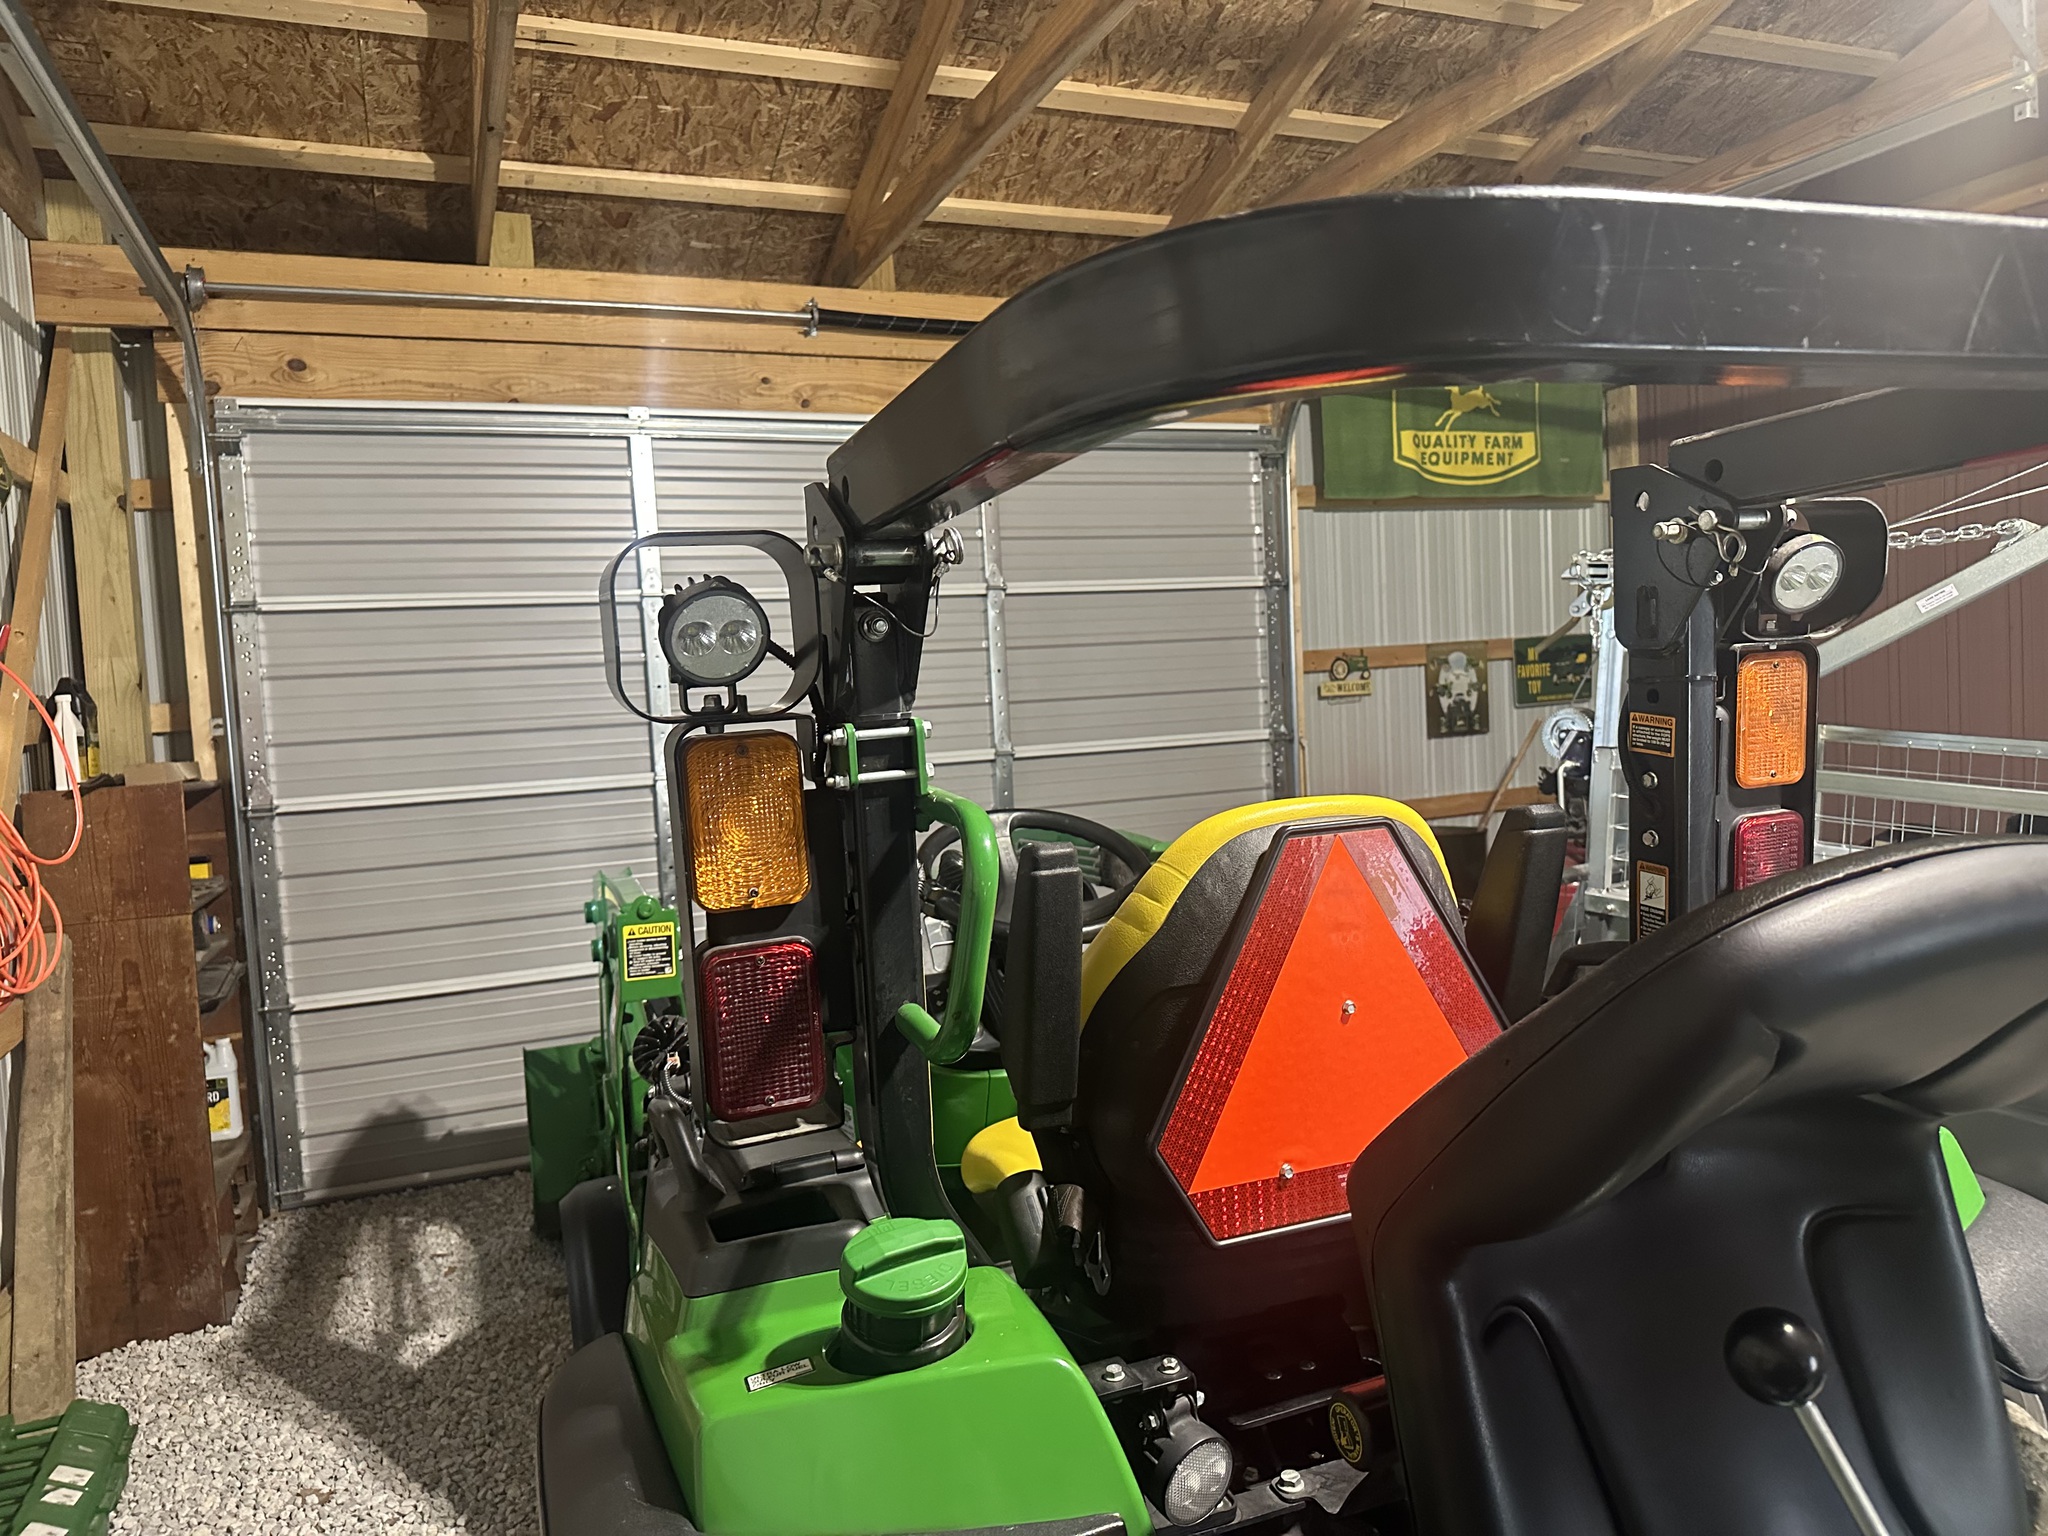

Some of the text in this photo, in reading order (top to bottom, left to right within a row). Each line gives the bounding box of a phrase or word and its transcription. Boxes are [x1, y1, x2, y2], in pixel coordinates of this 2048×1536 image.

[1412, 433, 1523, 449] QUALITY FARM
[1420, 451, 1514, 466] EQUIPMENT
[1527, 647, 1539, 661] MY
[1516, 662, 1551, 679] FAVORITE
[1337, 682, 1371, 693] WELCOME
[1527, 680, 1542, 695] TOY
[1638, 714, 1673, 727] WARNING
[637, 924, 672, 936] CAUTION
[886, 1262, 953, 1292] DIESEL
[781, 1362, 801, 1373] LOW
